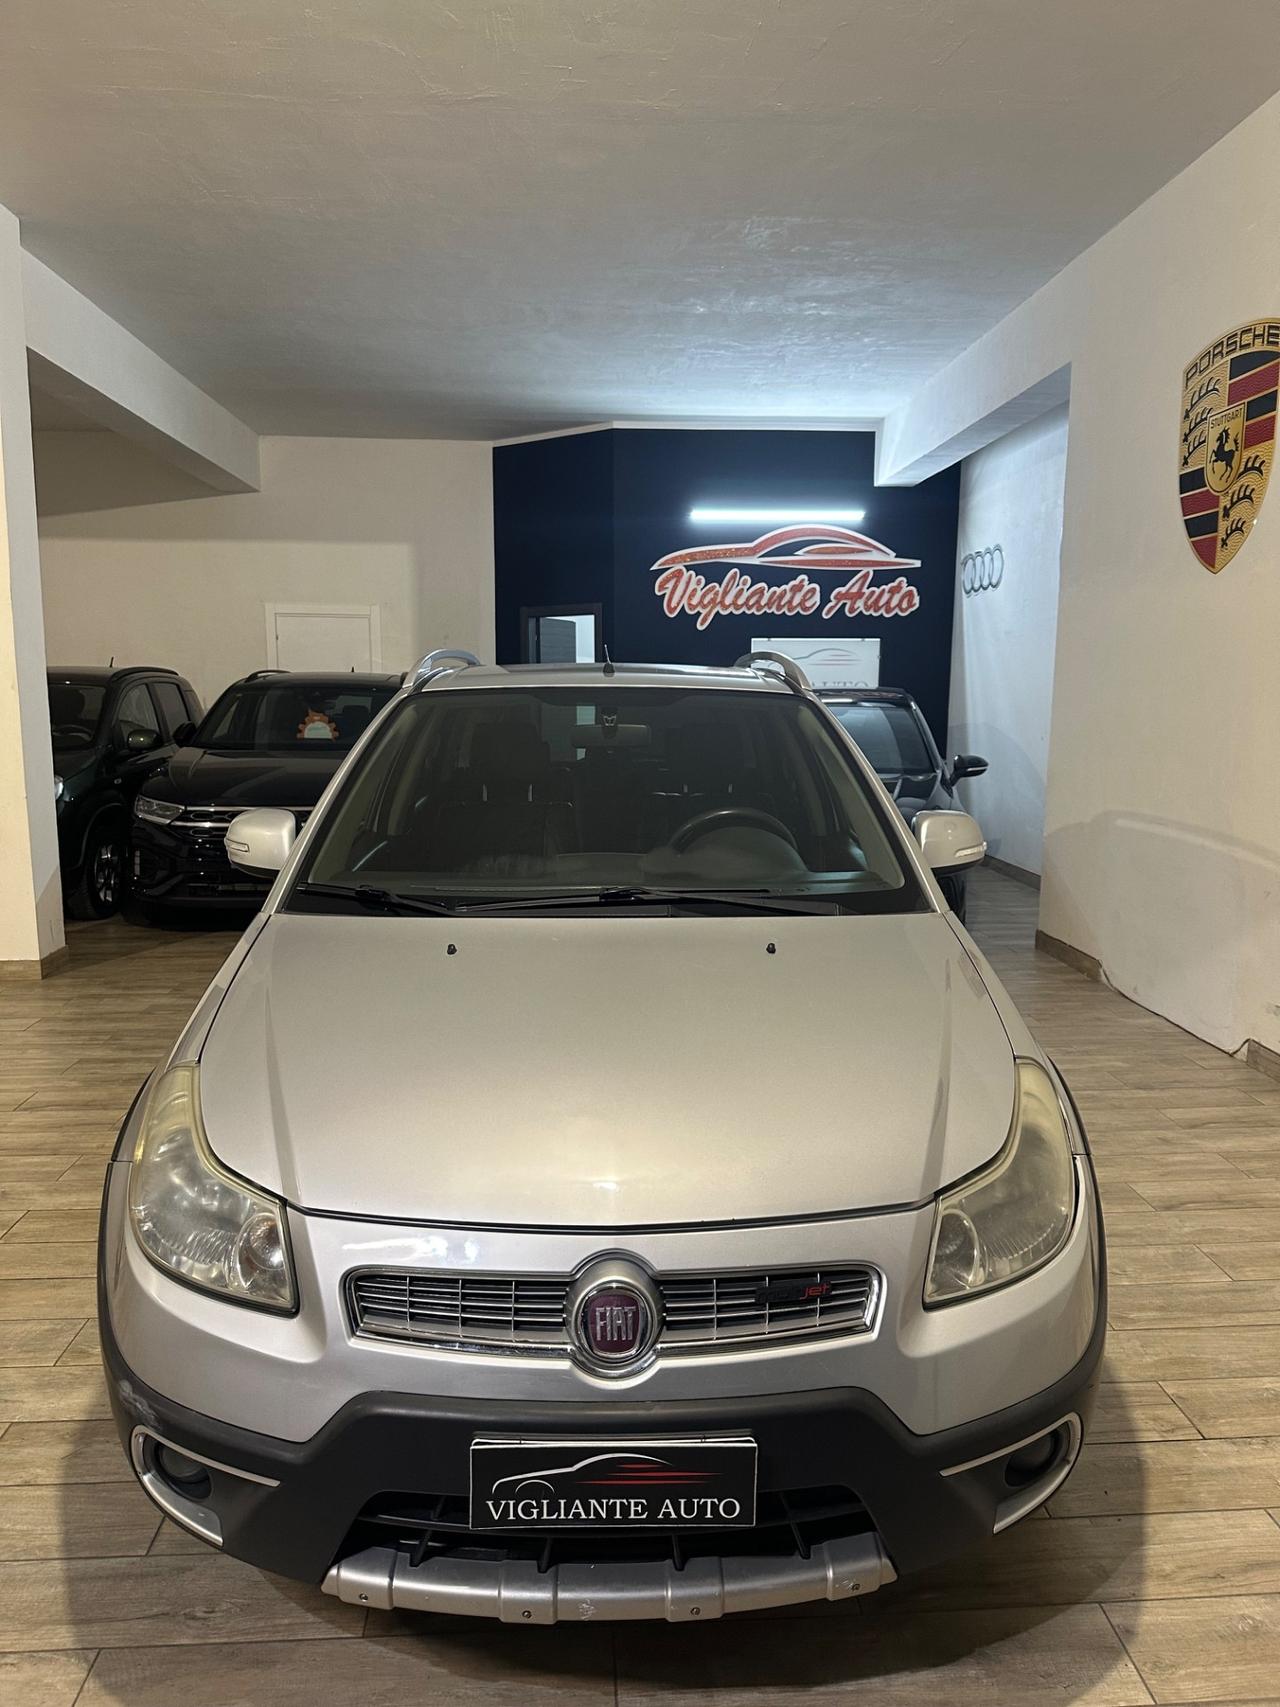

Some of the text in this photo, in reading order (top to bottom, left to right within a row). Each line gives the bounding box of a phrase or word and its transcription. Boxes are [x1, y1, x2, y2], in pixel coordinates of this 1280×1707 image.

[1185, 324, 1280, 391] PORSCHE
[655, 566, 920, 630] Vigliante Auto
[595, 1306, 636, 1341] FIAT
[485, 1498, 741, 1520] VIGLIANTE AUTO
